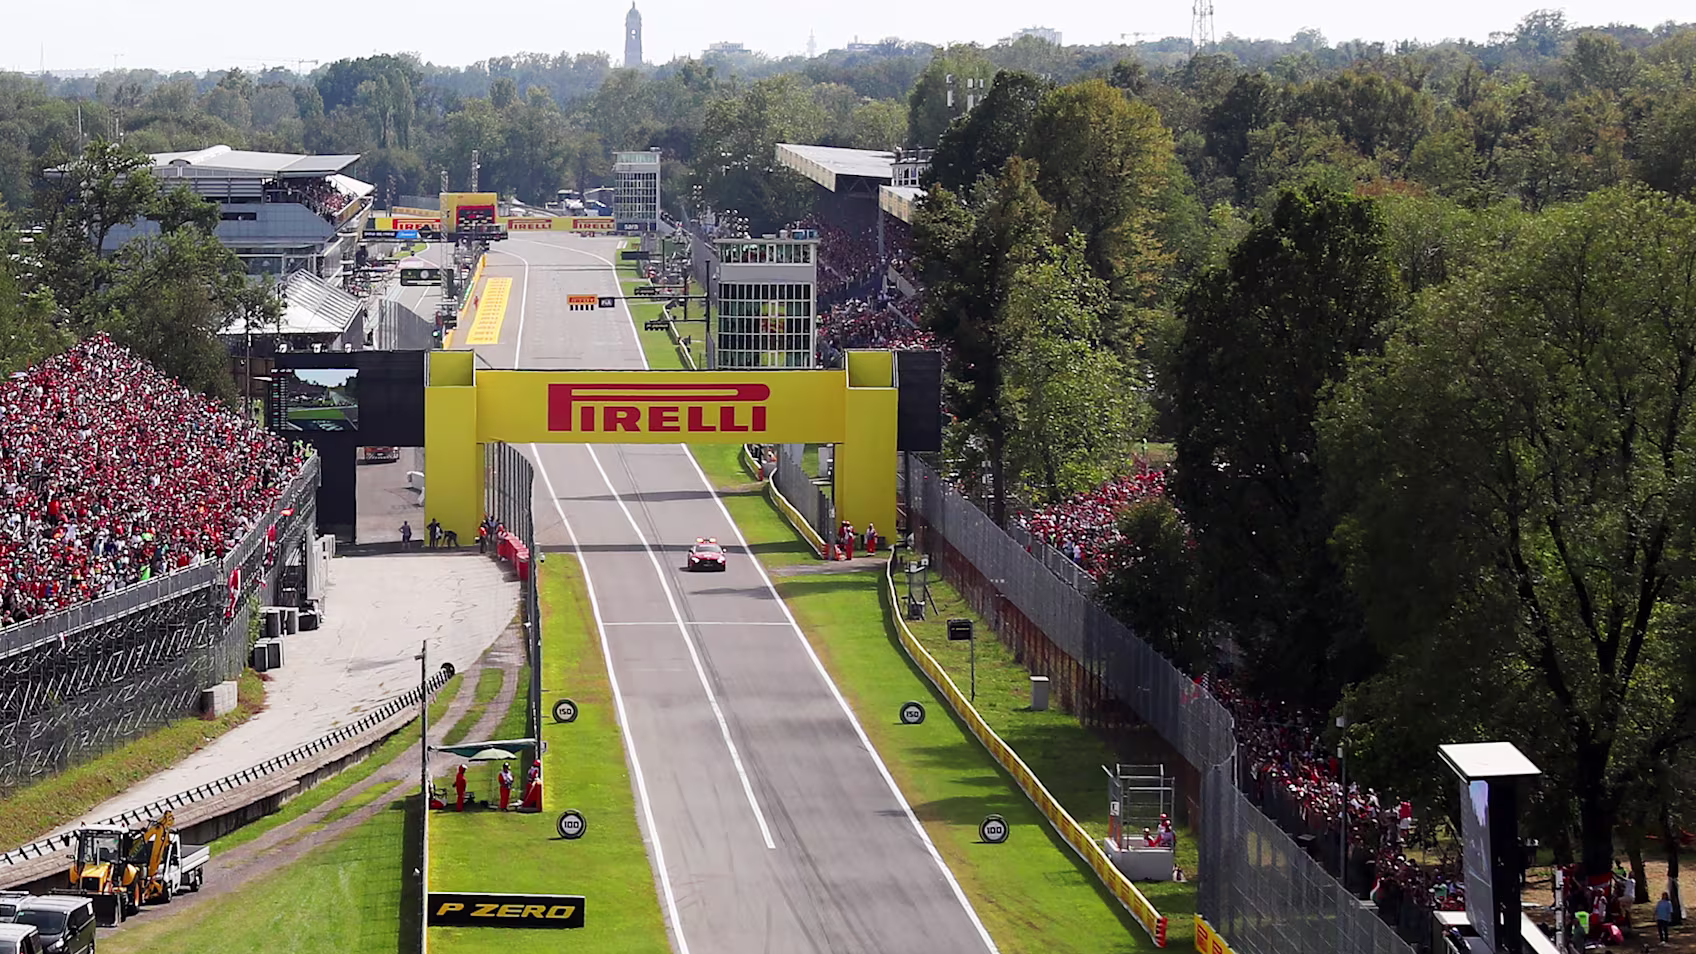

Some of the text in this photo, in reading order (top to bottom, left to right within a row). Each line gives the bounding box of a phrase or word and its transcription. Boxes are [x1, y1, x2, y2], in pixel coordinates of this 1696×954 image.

[508, 219, 551, 229] PIRELLI
[548, 384, 770, 432] PIRELLI
[436, 903, 576, 919] P ZERO
